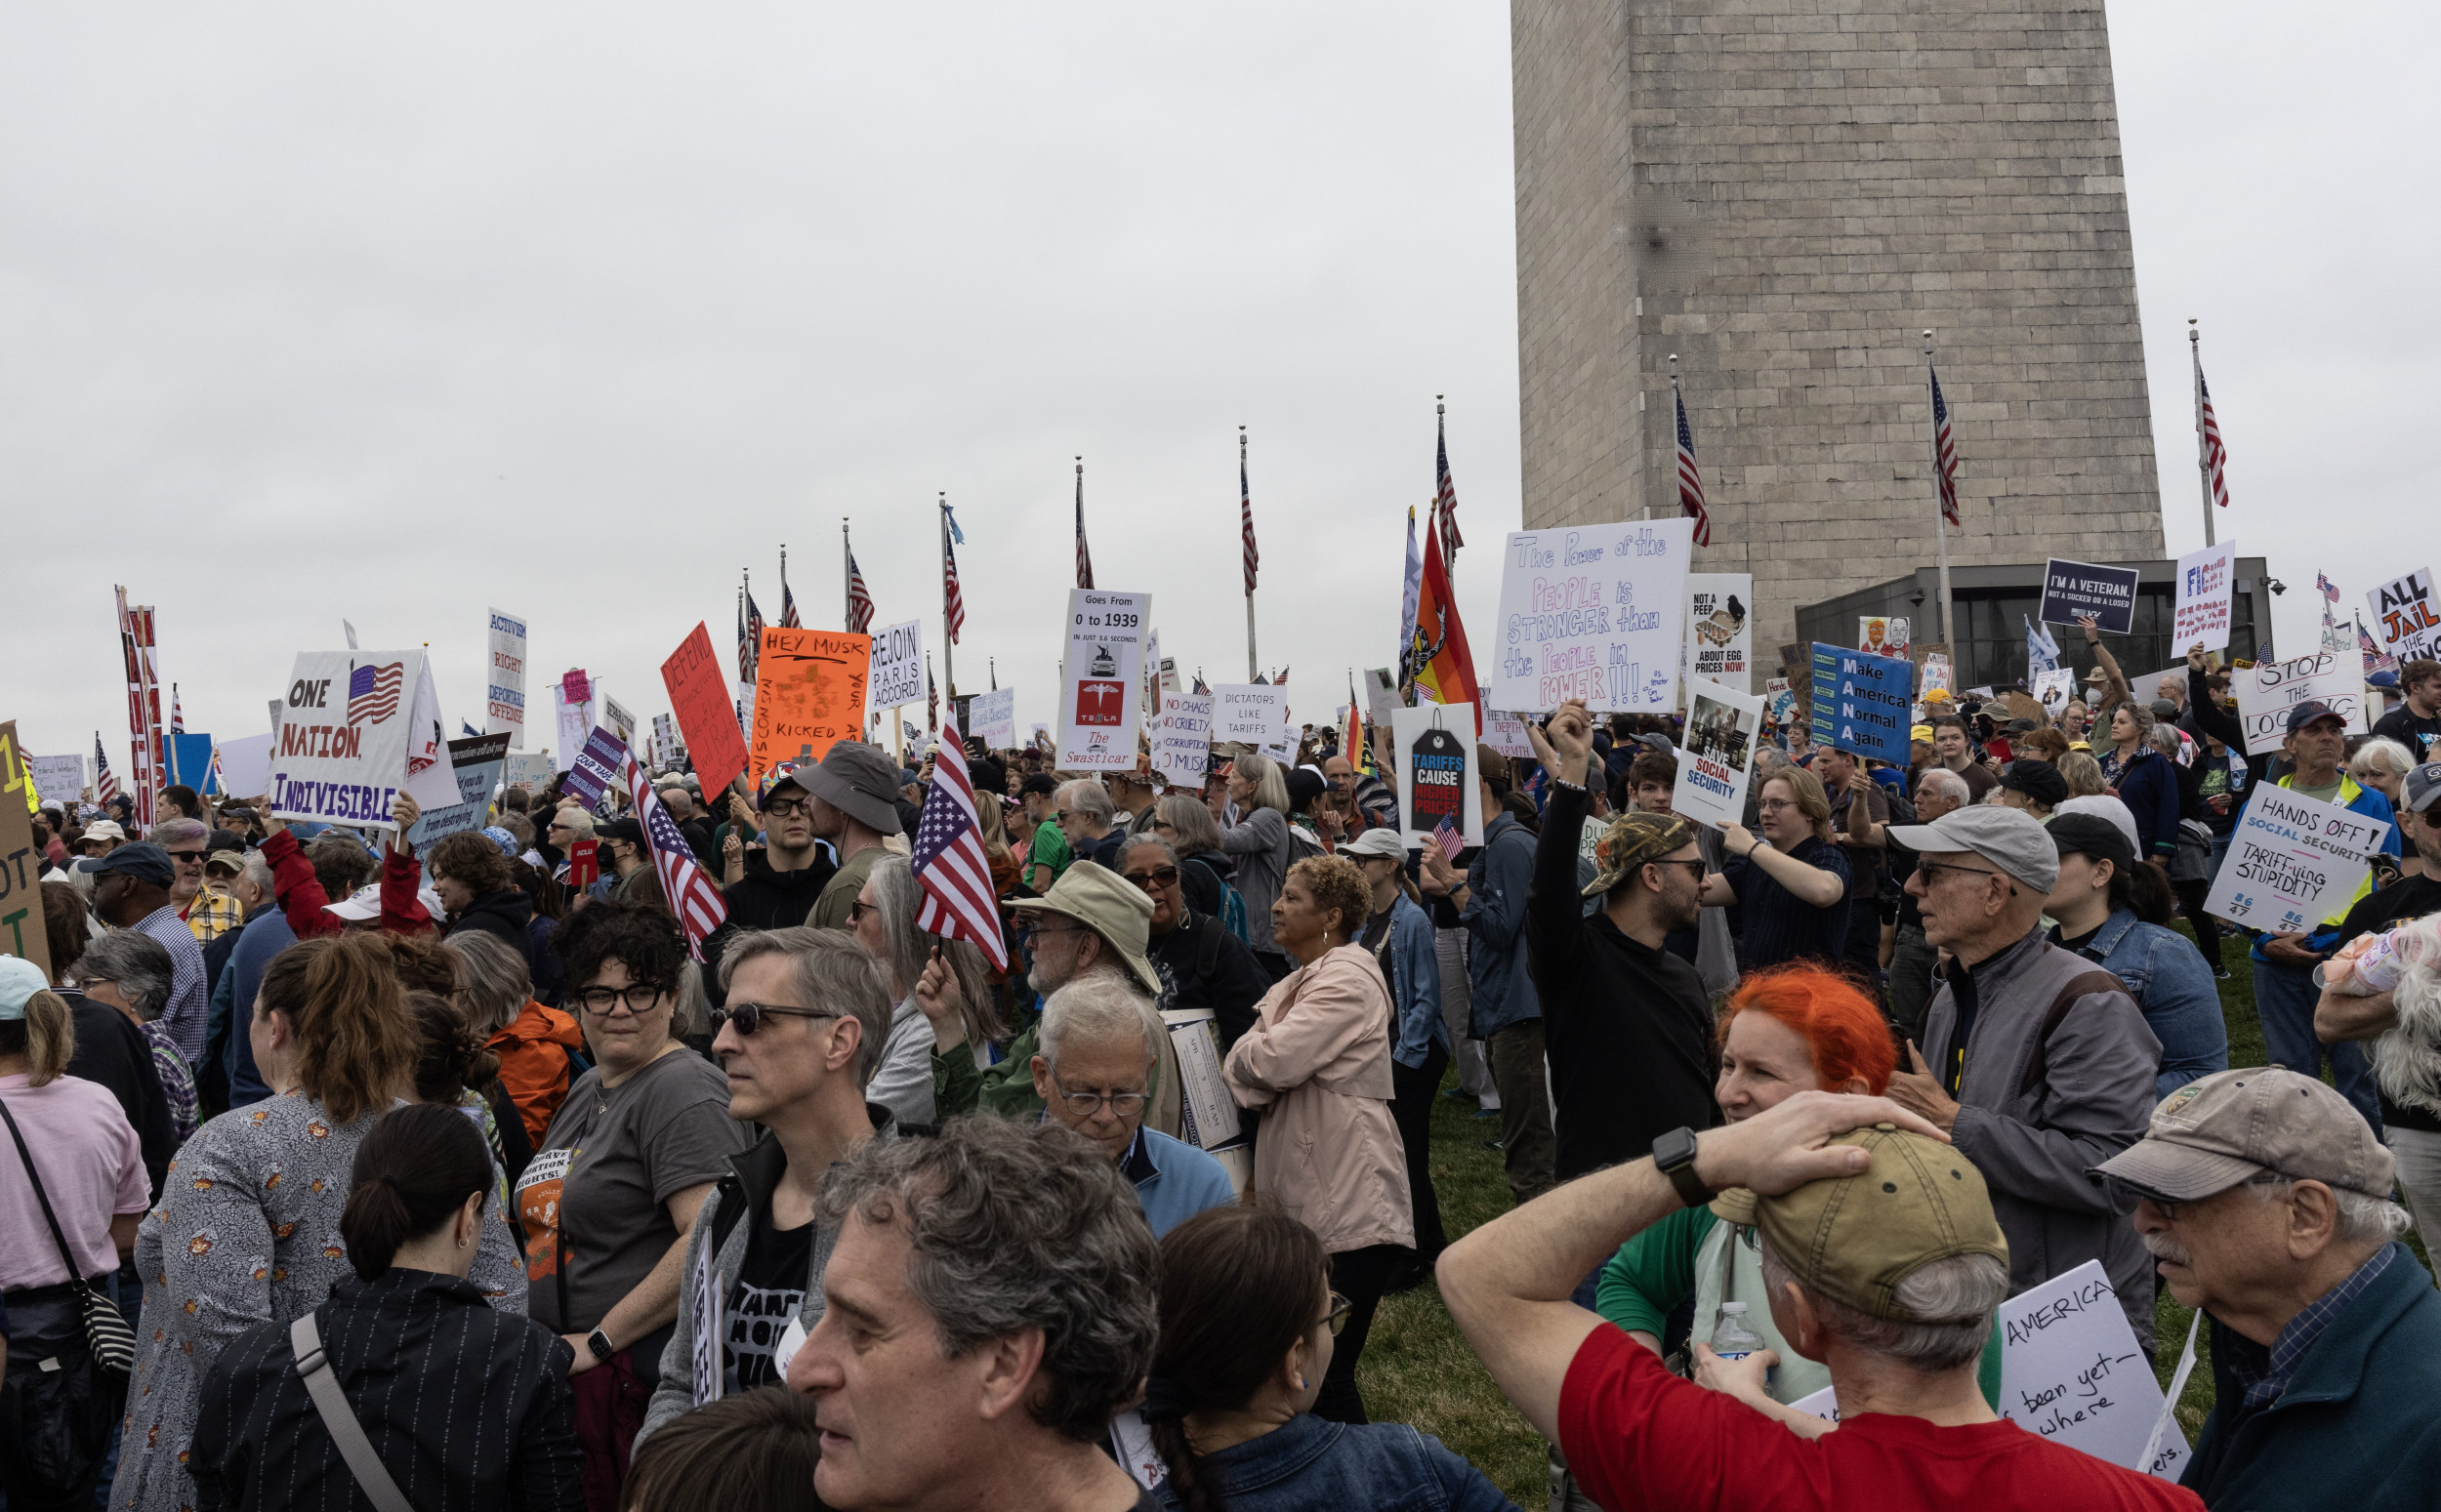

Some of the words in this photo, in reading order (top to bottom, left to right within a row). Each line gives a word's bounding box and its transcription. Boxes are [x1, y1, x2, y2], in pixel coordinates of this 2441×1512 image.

[1513, 537, 1554, 568] The
[1564, 532, 1603, 566] Power
[1615, 535, 1633, 556] of
[1635, 528, 1666, 556] the
[2187, 555, 2226, 597] FIGHT
[1533, 577, 1600, 612] PEOPLE
[1616, 581, 1632, 604] is
[2069, 578, 2076, 591] A
[2080, 580, 2131, 597] VETERAN.
[2380, 574, 2428, 614] ALL
[1085, 594, 1106, 605] Goes
[1110, 596, 1133, 606] From
[1694, 593, 1709, 604] NOT
[1711, 593, 1717, 604] A
[2067, 593, 2091, 603] SUCKER
[2109, 598, 2130, 608] LOSER
[1075, 613, 1083, 625] 0
[1089, 615, 1100, 626] to
[1105, 613, 1138, 628] 1939
[1694, 605, 1713, 615] PEEP
[490, 614, 526, 639] ACTIVISM
[1508, 606, 1610, 644] STRONGER
[1617, 606, 1660, 632] than
[766, 633, 805, 651] HEY
[813, 638, 865, 656] MUSK
[871, 625, 917, 670] REJOIN
[2402, 633, 2425, 651] THE
[494, 652, 521, 674] RIGHT
[662, 625, 711, 694] DEFEND
[1505, 647, 1533, 678] the
[1543, 643, 1595, 674] PEOPLE
[1610, 642, 1628, 664] in
[1699, 651, 1725, 661] ABOUT
[1726, 651, 1742, 661] EGG
[874, 662, 918, 689] PARIS
[1695, 662, 1722, 674] PRICES
[1724, 661, 1746, 672] NOW!
[1842, 658, 1883, 679] Make
[2259, 655, 2333, 685] STOP
[289, 678, 331, 708] ONE
[489, 684, 525, 708] DEPORTABLE
[672, 664, 721, 719] Democracy
[847, 673, 863, 711] YOUR
[874, 680, 920, 707] ACCORD!
[1225, 694, 1274, 704] DICTATORS
[1841, 681, 1907, 708] America
[2285, 683, 2310, 704] THE
[489, 702, 523, 724] OFFENSE
[607, 701, 635, 734] SEPARATION
[1166, 699, 1179, 710] NO
[1181, 700, 1211, 715] CHAOS
[1238, 710, 1262, 719] LIKE
[1487, 711, 1500, 721] HE
[1842, 702, 1896, 729] Normal
[753, 678, 773, 777] WISCONSIN
[776, 722, 836, 739] KICKED
[1175, 716, 1210, 732] CRUELTY
[1228, 723, 1266, 734] TARIFFS
[1495, 722, 1522, 733] DEPTH
[280, 723, 361, 760] NATION,
[1089, 731, 1109, 744] The
[1165, 737, 1209, 750] CORRUPTION
[1506, 733, 1513, 744] &
[1841, 725, 1883, 748] Again
[1065, 751, 1129, 764] Swasticar
[1491, 746, 1530, 756] WARMTH
[1703, 746, 1730, 765] SAVE
[33, 762, 55, 774] Federal
[57, 761, 77, 773] Workers
[575, 754, 596, 772] COUP
[596, 766, 615, 782] RAGE
[1175, 754, 1208, 772] MUSK
[1413, 755, 1464, 771] TARIFFS
[1696, 758, 1730, 783] SOCIAL
[40, 780, 55, 793] Serve
[1417, 769, 1458, 786] CAUSE
[1687, 770, 1736, 799] SECURITY
[271, 773, 395, 822] INDIVISIBLE
[1415, 784, 1460, 801] HIGHER
[1415, 799, 1459, 816] PRICES
[2260, 797, 2321, 831] HANDS
[2247, 816, 2298, 841] SOCIAL
[2301, 835, 2371, 865] SECURITY
[2236, 862, 2323, 901] STUPIDITY
[2234, 892, 2254, 907] 86
[2228, 906, 2249, 917] 47
[2285, 911, 2303, 923] 86
[517, 1169, 559, 1189] RIGHTS!
[2006, 1280, 2117, 1347] AMERICA
[2022, 1383, 2067, 1416] been
[2039, 1396, 2115, 1437] where
